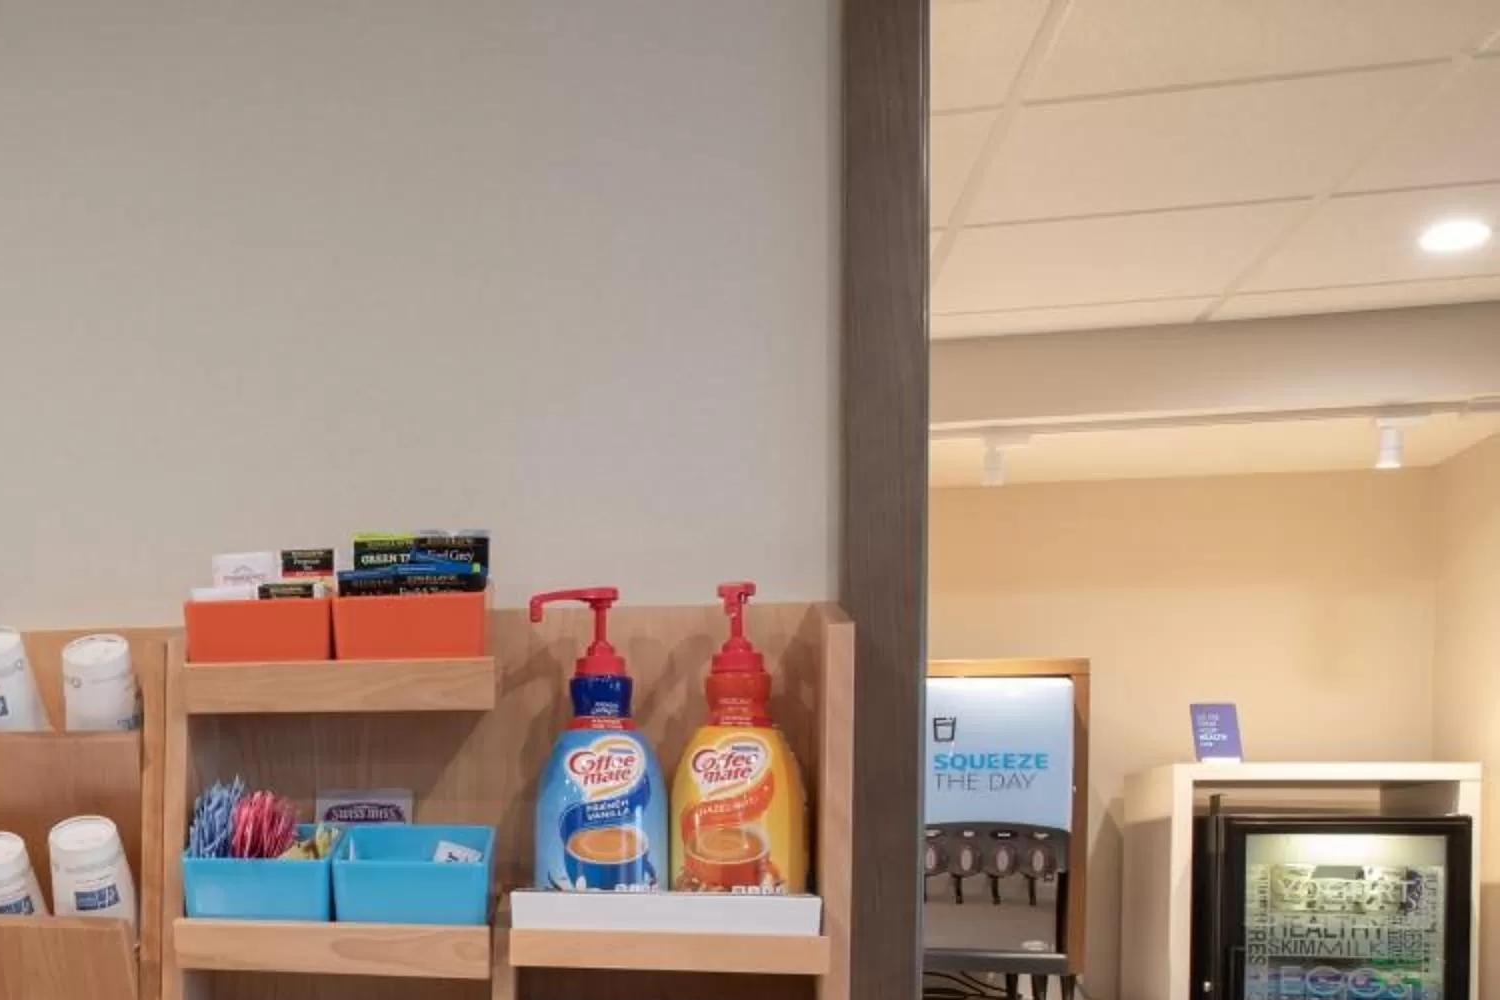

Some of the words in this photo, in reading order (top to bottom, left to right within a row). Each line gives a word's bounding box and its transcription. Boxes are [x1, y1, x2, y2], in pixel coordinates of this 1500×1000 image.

[569, 752, 637, 775] Coffee
[692, 749, 759, 774] Coffee
[933, 752, 1049, 770] SQUEEZE
[584, 768, 631, 787] mate
[703, 767, 754, 785] mate
[935, 773, 981, 791] THE
[988, 773, 1038, 792] DAY
[586, 807, 631, 821] VANILLA
